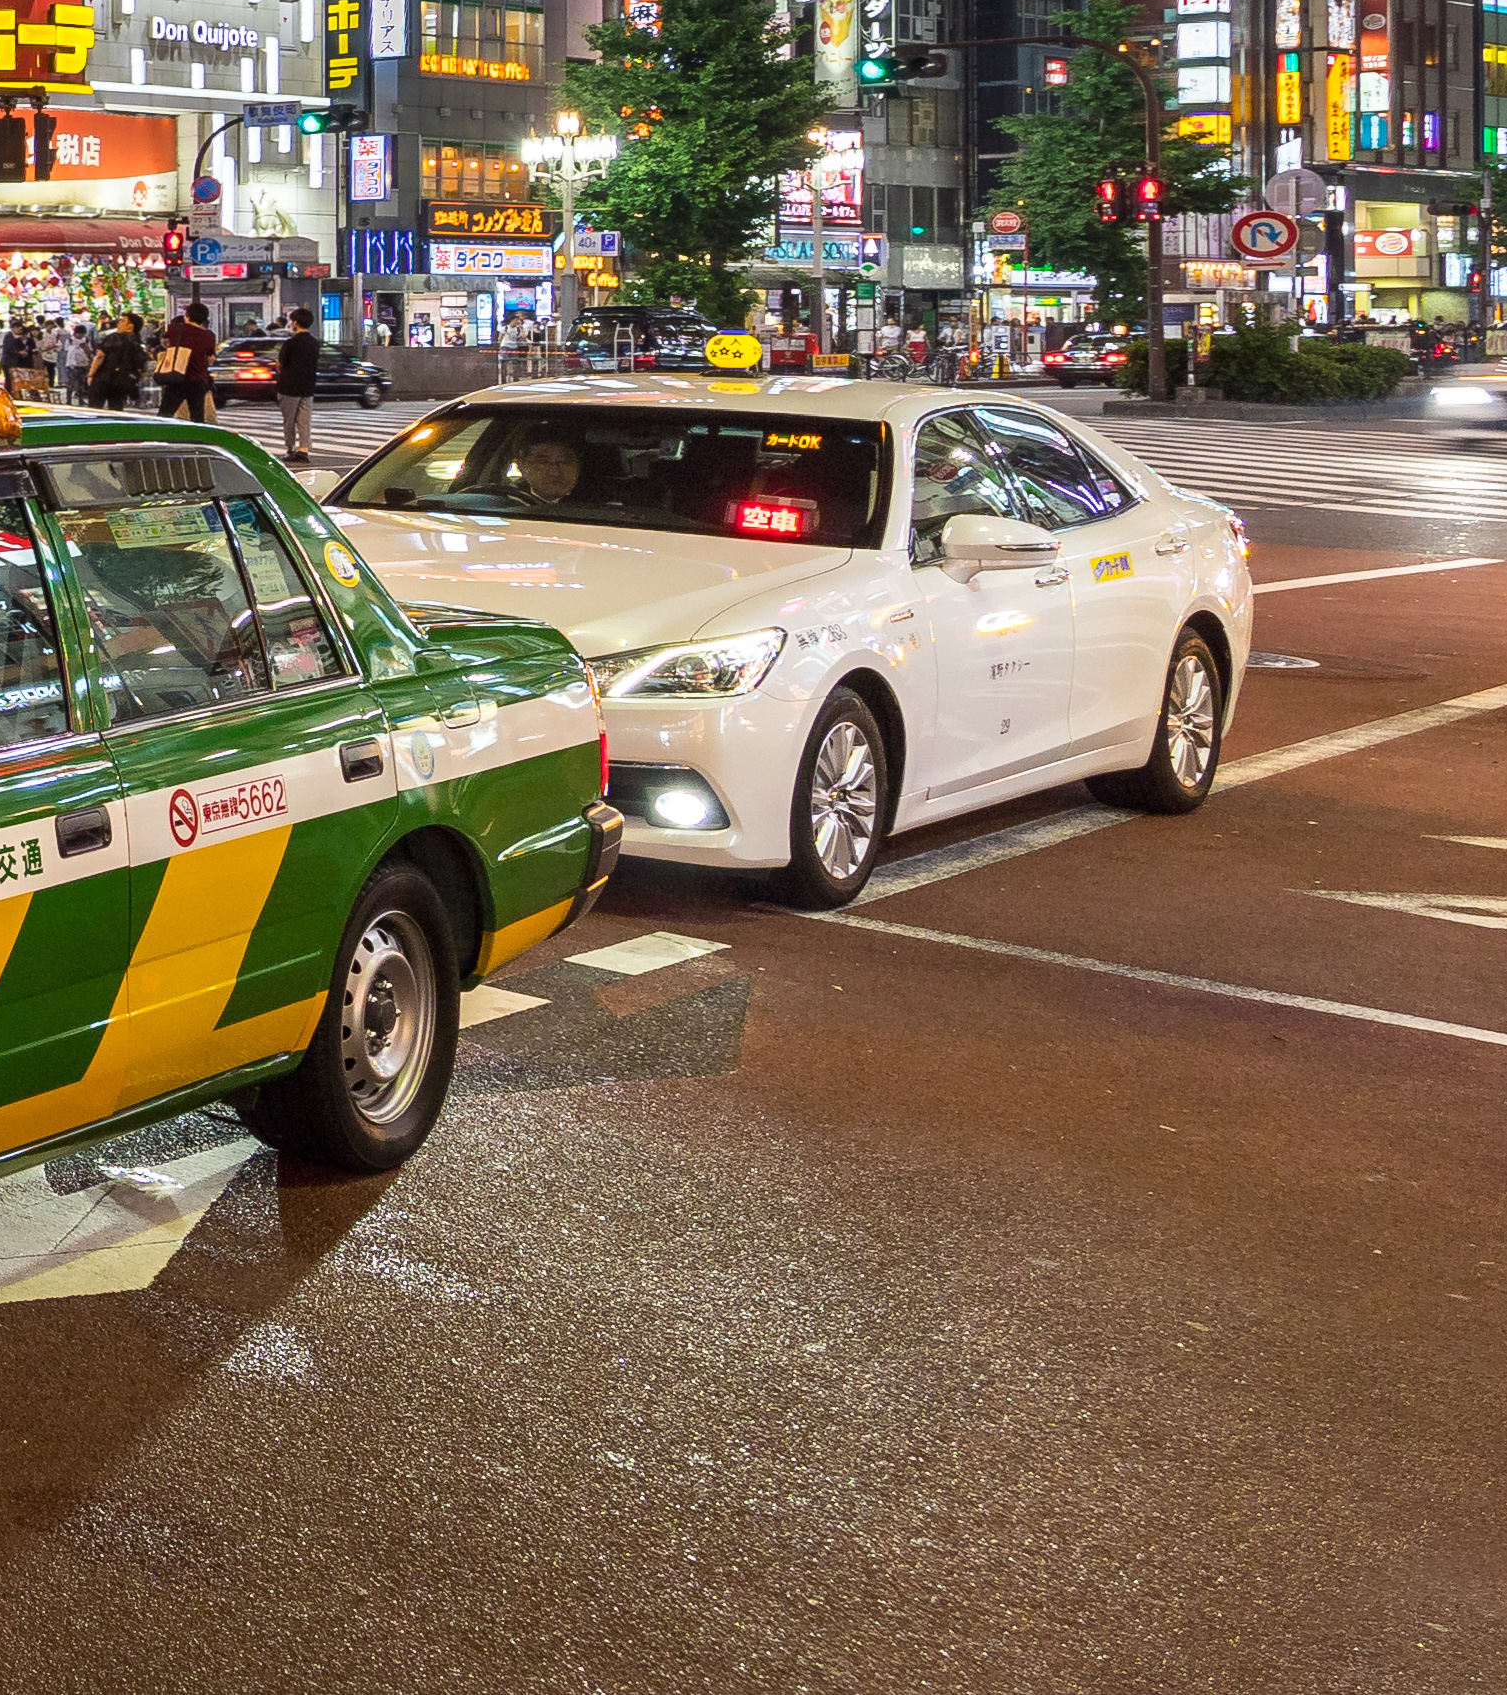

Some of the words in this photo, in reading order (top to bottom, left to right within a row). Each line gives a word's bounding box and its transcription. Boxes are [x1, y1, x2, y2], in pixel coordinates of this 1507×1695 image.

[151, 16, 188, 43] Don
[193, 18, 258, 51] Quijote
[767, 434, 823, 450] カードOK
[742, 507, 798, 532] 空車
